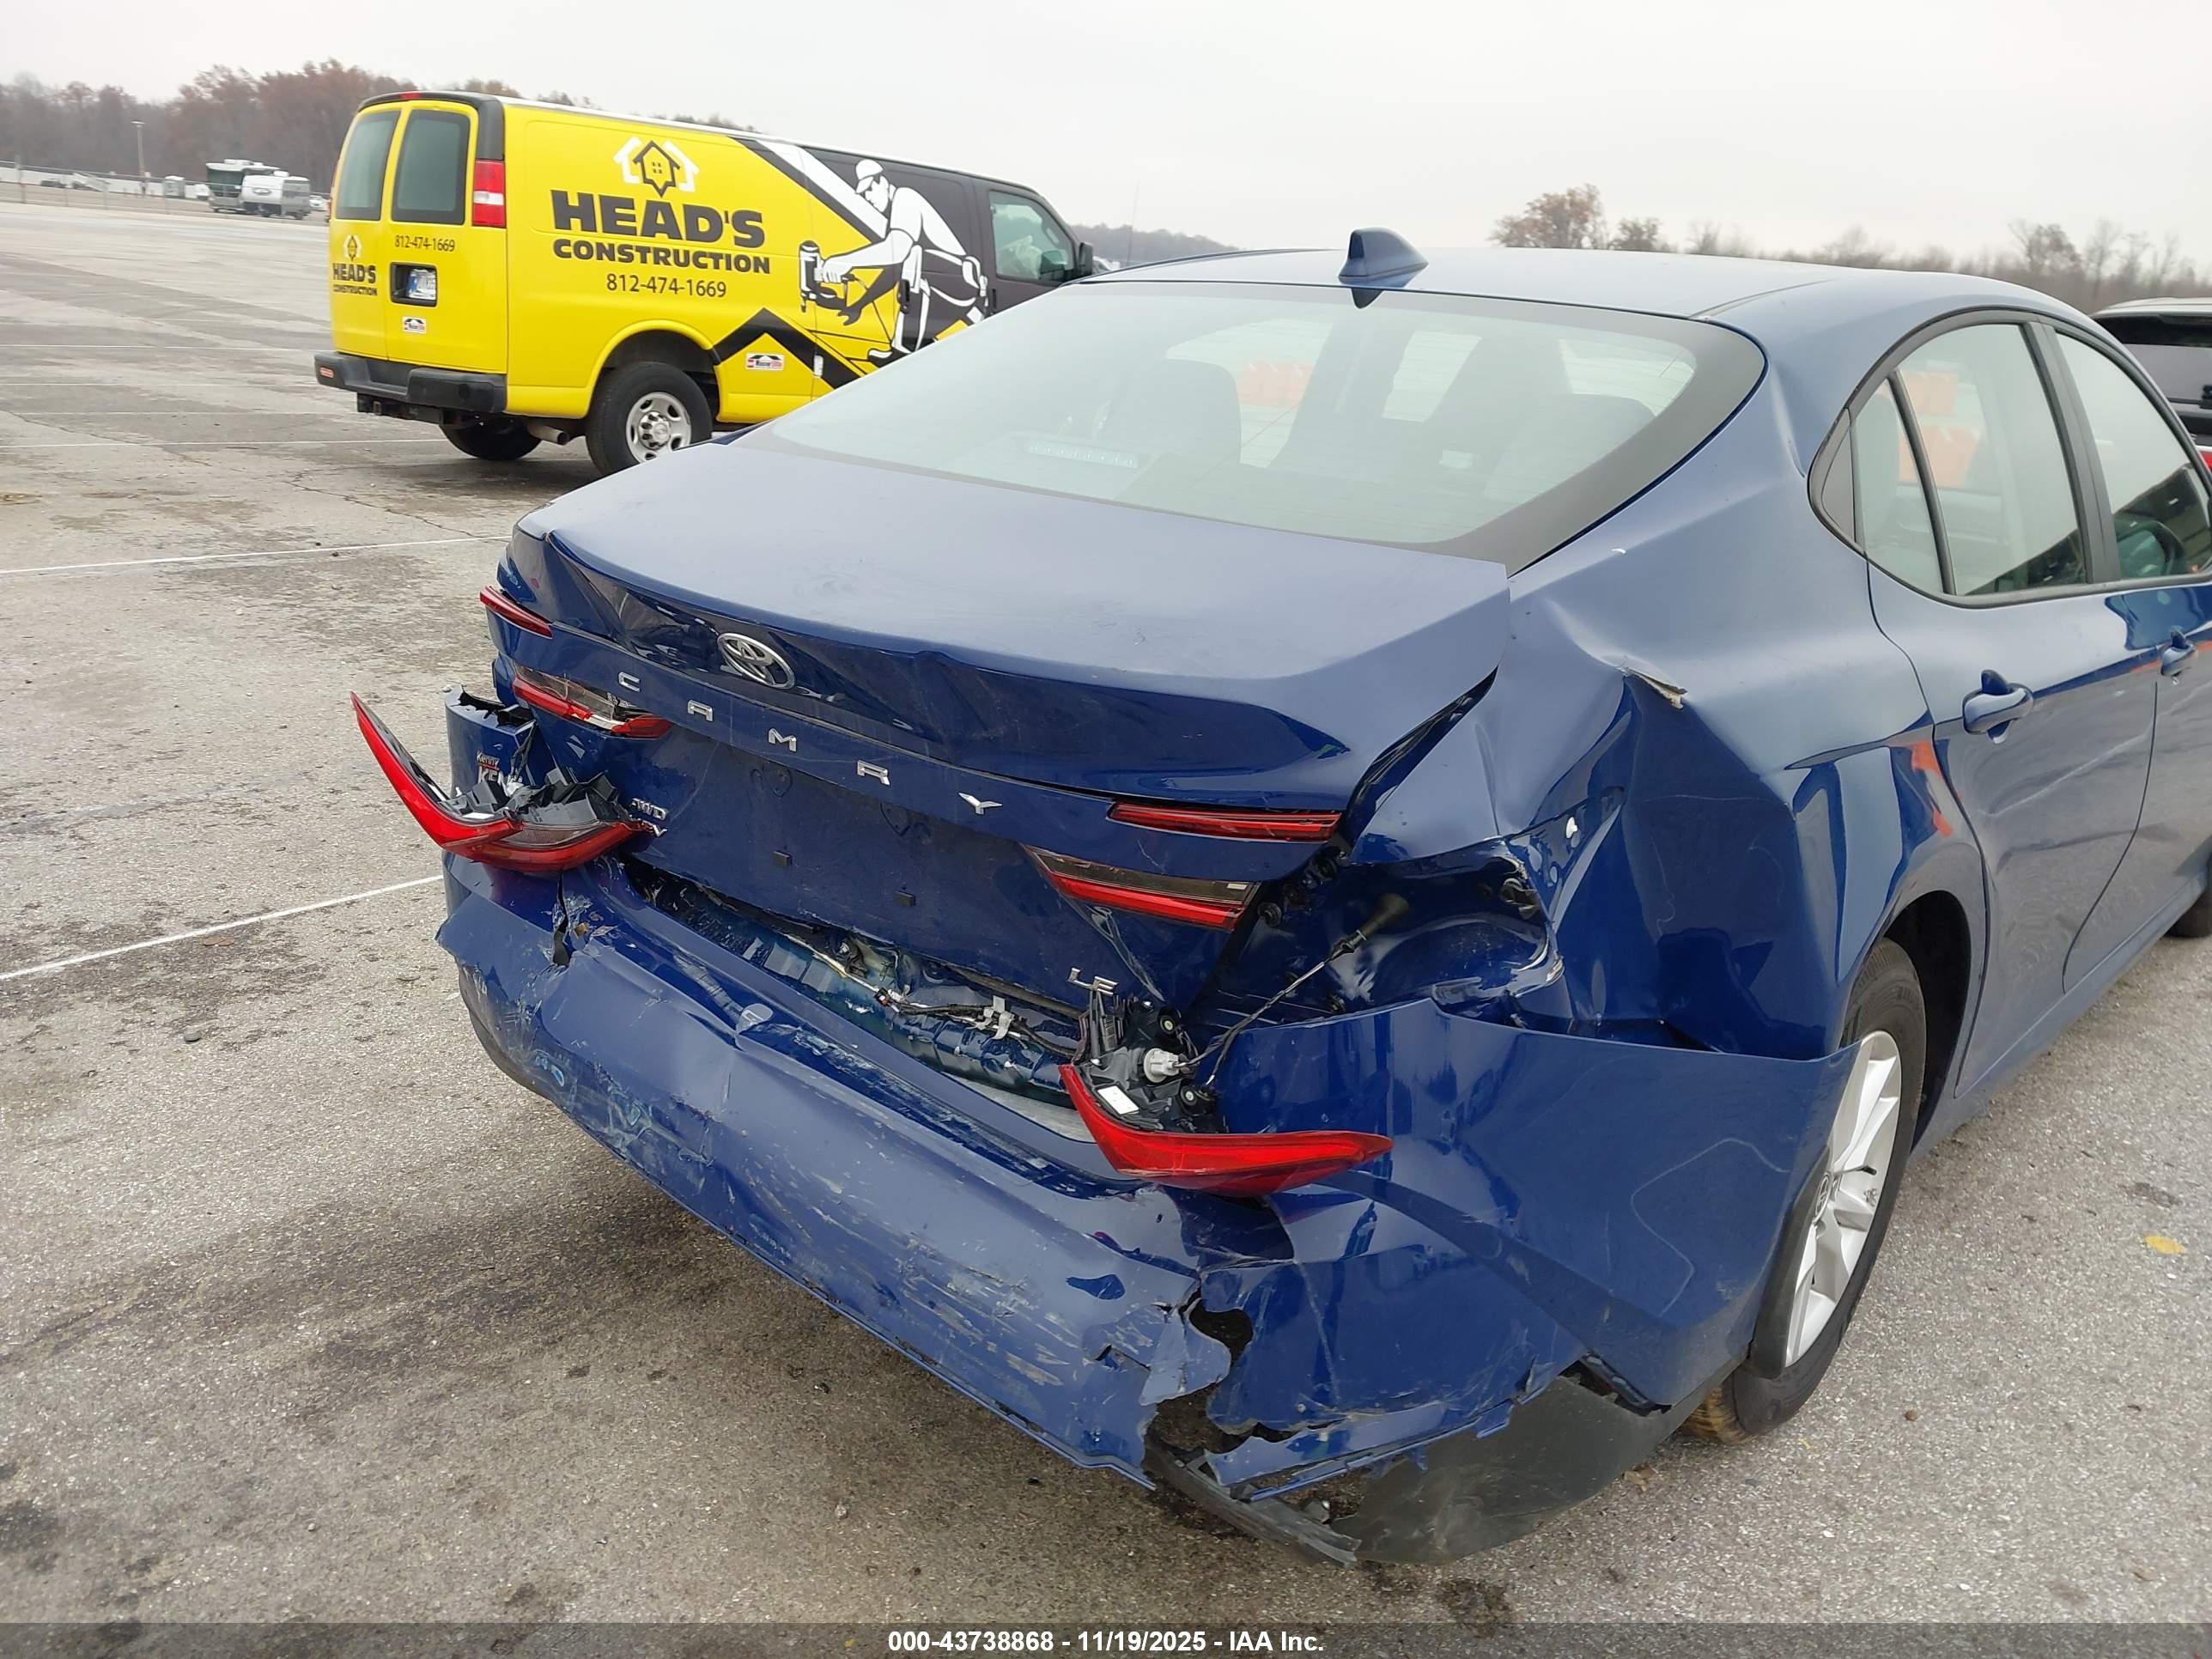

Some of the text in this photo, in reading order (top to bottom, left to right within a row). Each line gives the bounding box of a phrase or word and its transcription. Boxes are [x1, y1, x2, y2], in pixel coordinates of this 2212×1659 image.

[550, 189, 765, 248] HEAD'S
[394, 234, 456, 252] 812-474-1669
[553, 238, 770, 274] CONSTRUCTION
[332, 262, 376, 284] HEAD'S
[606, 273, 726, 298] 812-474-1669
[618, 672, 1003, 815] CAMRY
[1067, 968, 1118, 995] LE
